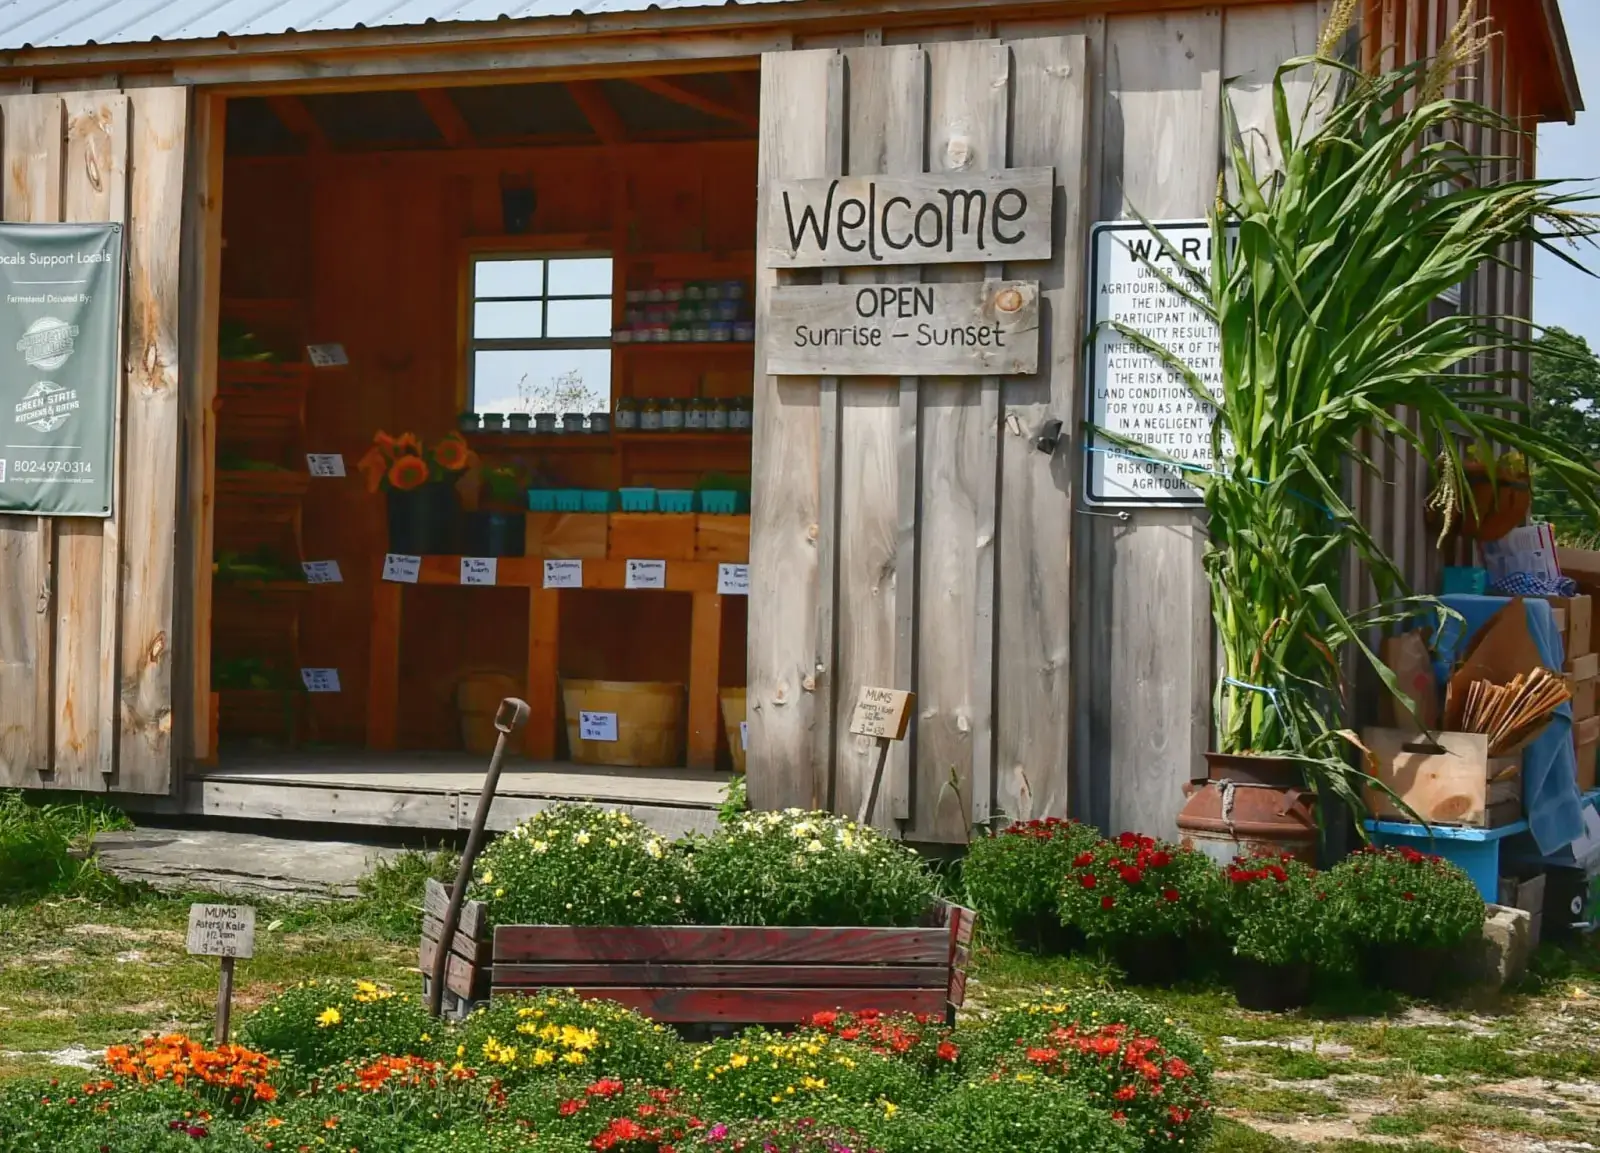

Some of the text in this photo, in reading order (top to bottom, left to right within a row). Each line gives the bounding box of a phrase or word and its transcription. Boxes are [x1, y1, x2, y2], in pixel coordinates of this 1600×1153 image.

[782, 179, 1028, 261] Welcome
[29, 252, 74, 268] Support
[77, 249, 111, 264] Locals
[7, 293, 92, 305] Farmstand Donated By:
[856, 287, 934, 318] OPEN
[1132, 298, 1152, 309] THE
[1115, 312, 1185, 324] PARTICIPANT
[1189, 312, 1200, 324] IN
[794, 325, 882, 347] Sunrise
[916, 321, 1007, 347] Sunset
[1189, 342, 1202, 353] OF
[1115, 373, 1134, 384] THE
[1138, 373, 1162, 384] RISK
[1167, 372, 1181, 384] OF
[1097, 387, 1124, 399] LAND
[16, 389, 77, 412] GREEN STATE
[1106, 402, 1127, 414] FOR
[1132, 402, 1154, 414] YOU
[1158, 402, 1171, 414] AS
[1175, 402, 1182, 413] A
[16, 407, 46, 423] KITCHENS
[1119, 418, 1129, 429] IN
[1133, 418, 1140, 428] A
[1144, 417, 1203, 429] NEGLIGENT
[1180, 432, 1192, 443] TO
[1166, 448, 1189, 460] YOU
[14, 460, 92, 473] 802-497-0314
[1116, 463, 1141, 475] RISK
[1145, 463, 1158, 475] OF
[866, 689, 893, 703] MUMS
[205, 908, 237, 919] MUMS
